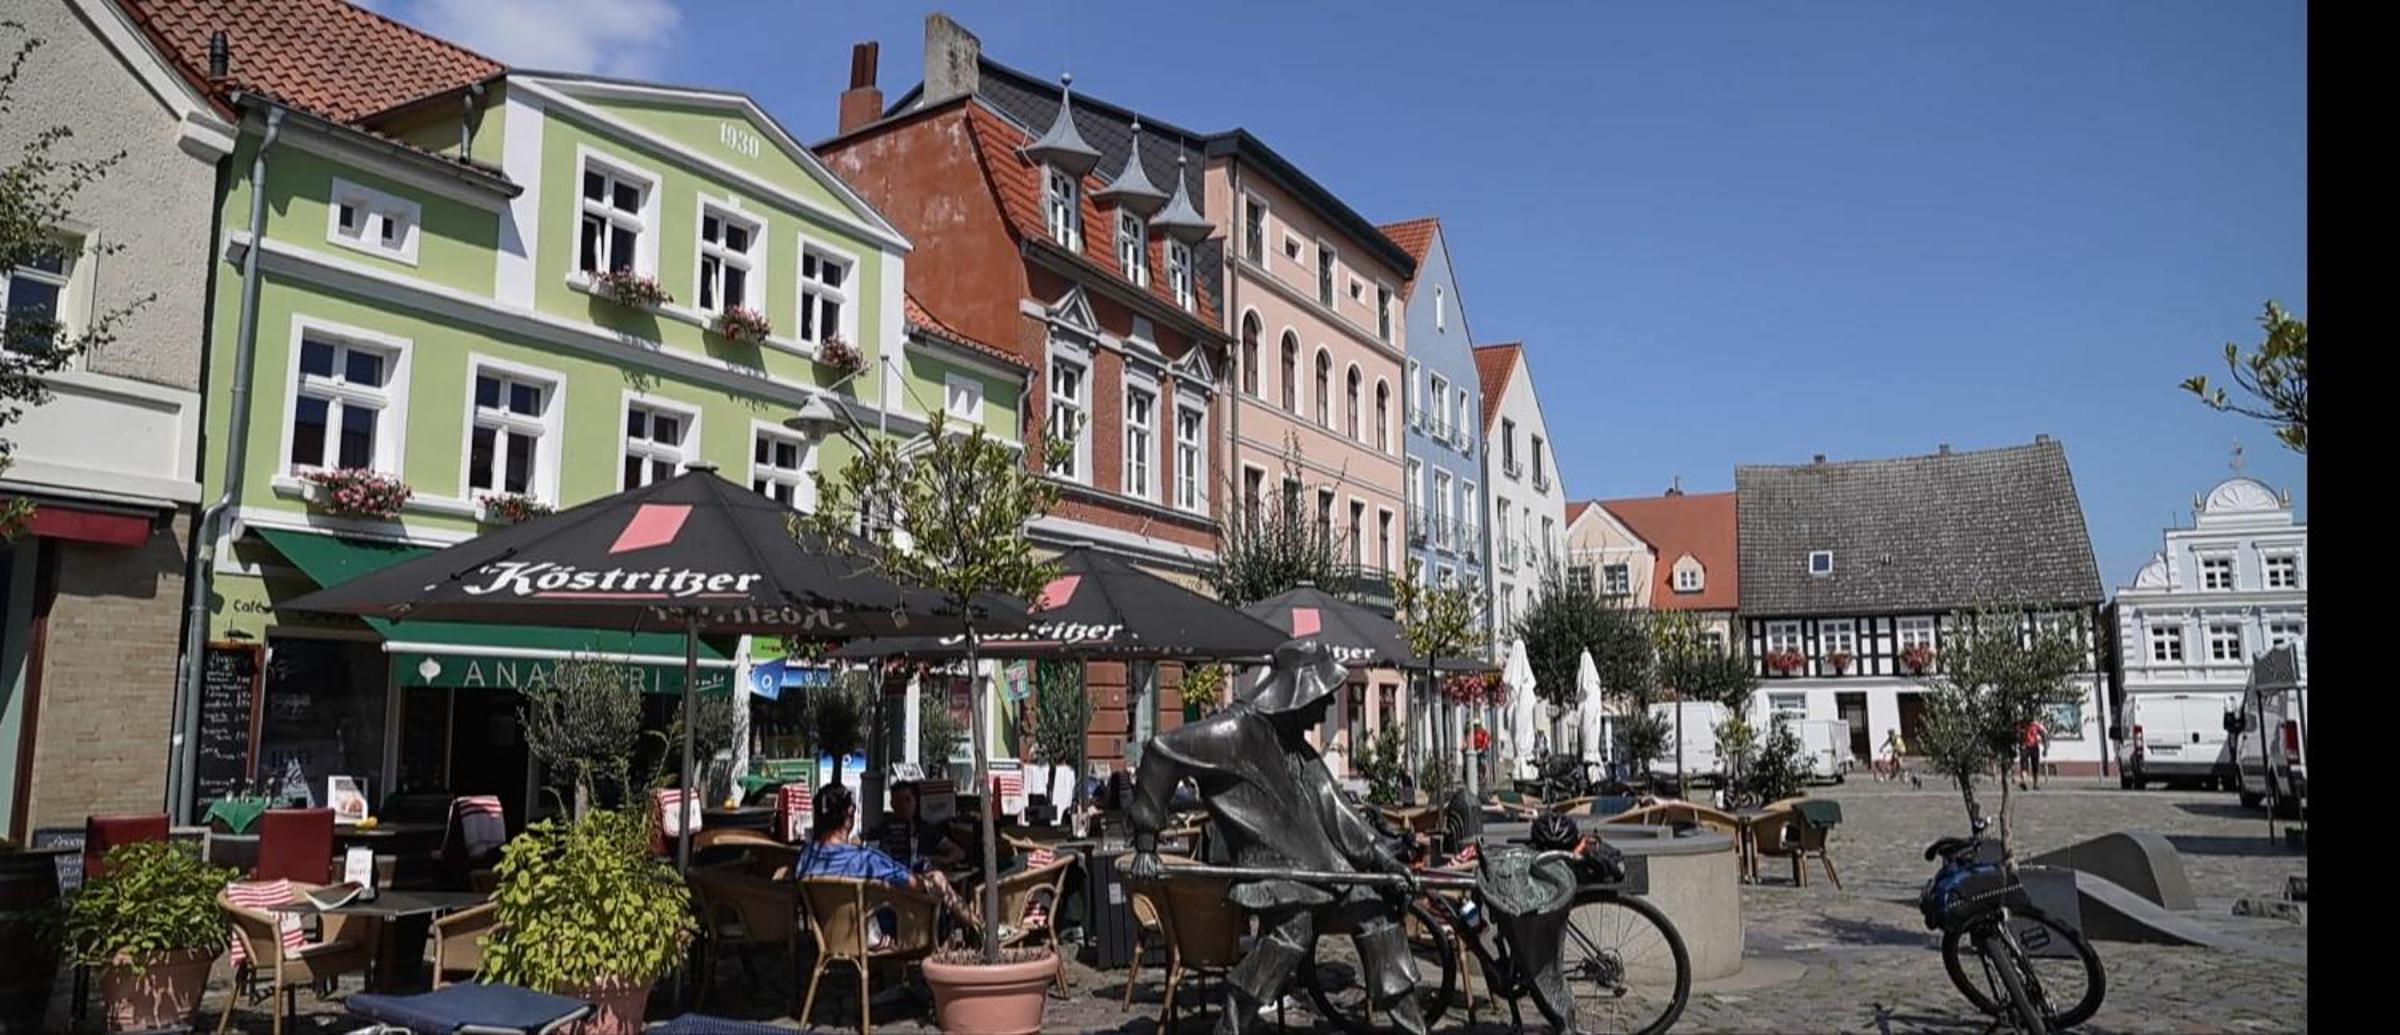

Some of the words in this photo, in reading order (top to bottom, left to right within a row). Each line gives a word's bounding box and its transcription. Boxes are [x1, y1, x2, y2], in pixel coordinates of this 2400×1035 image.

[721, 122, 760, 159] 1930
[463, 561, 762, 598] Köstritzer
[233, 599, 263, 613] Café
